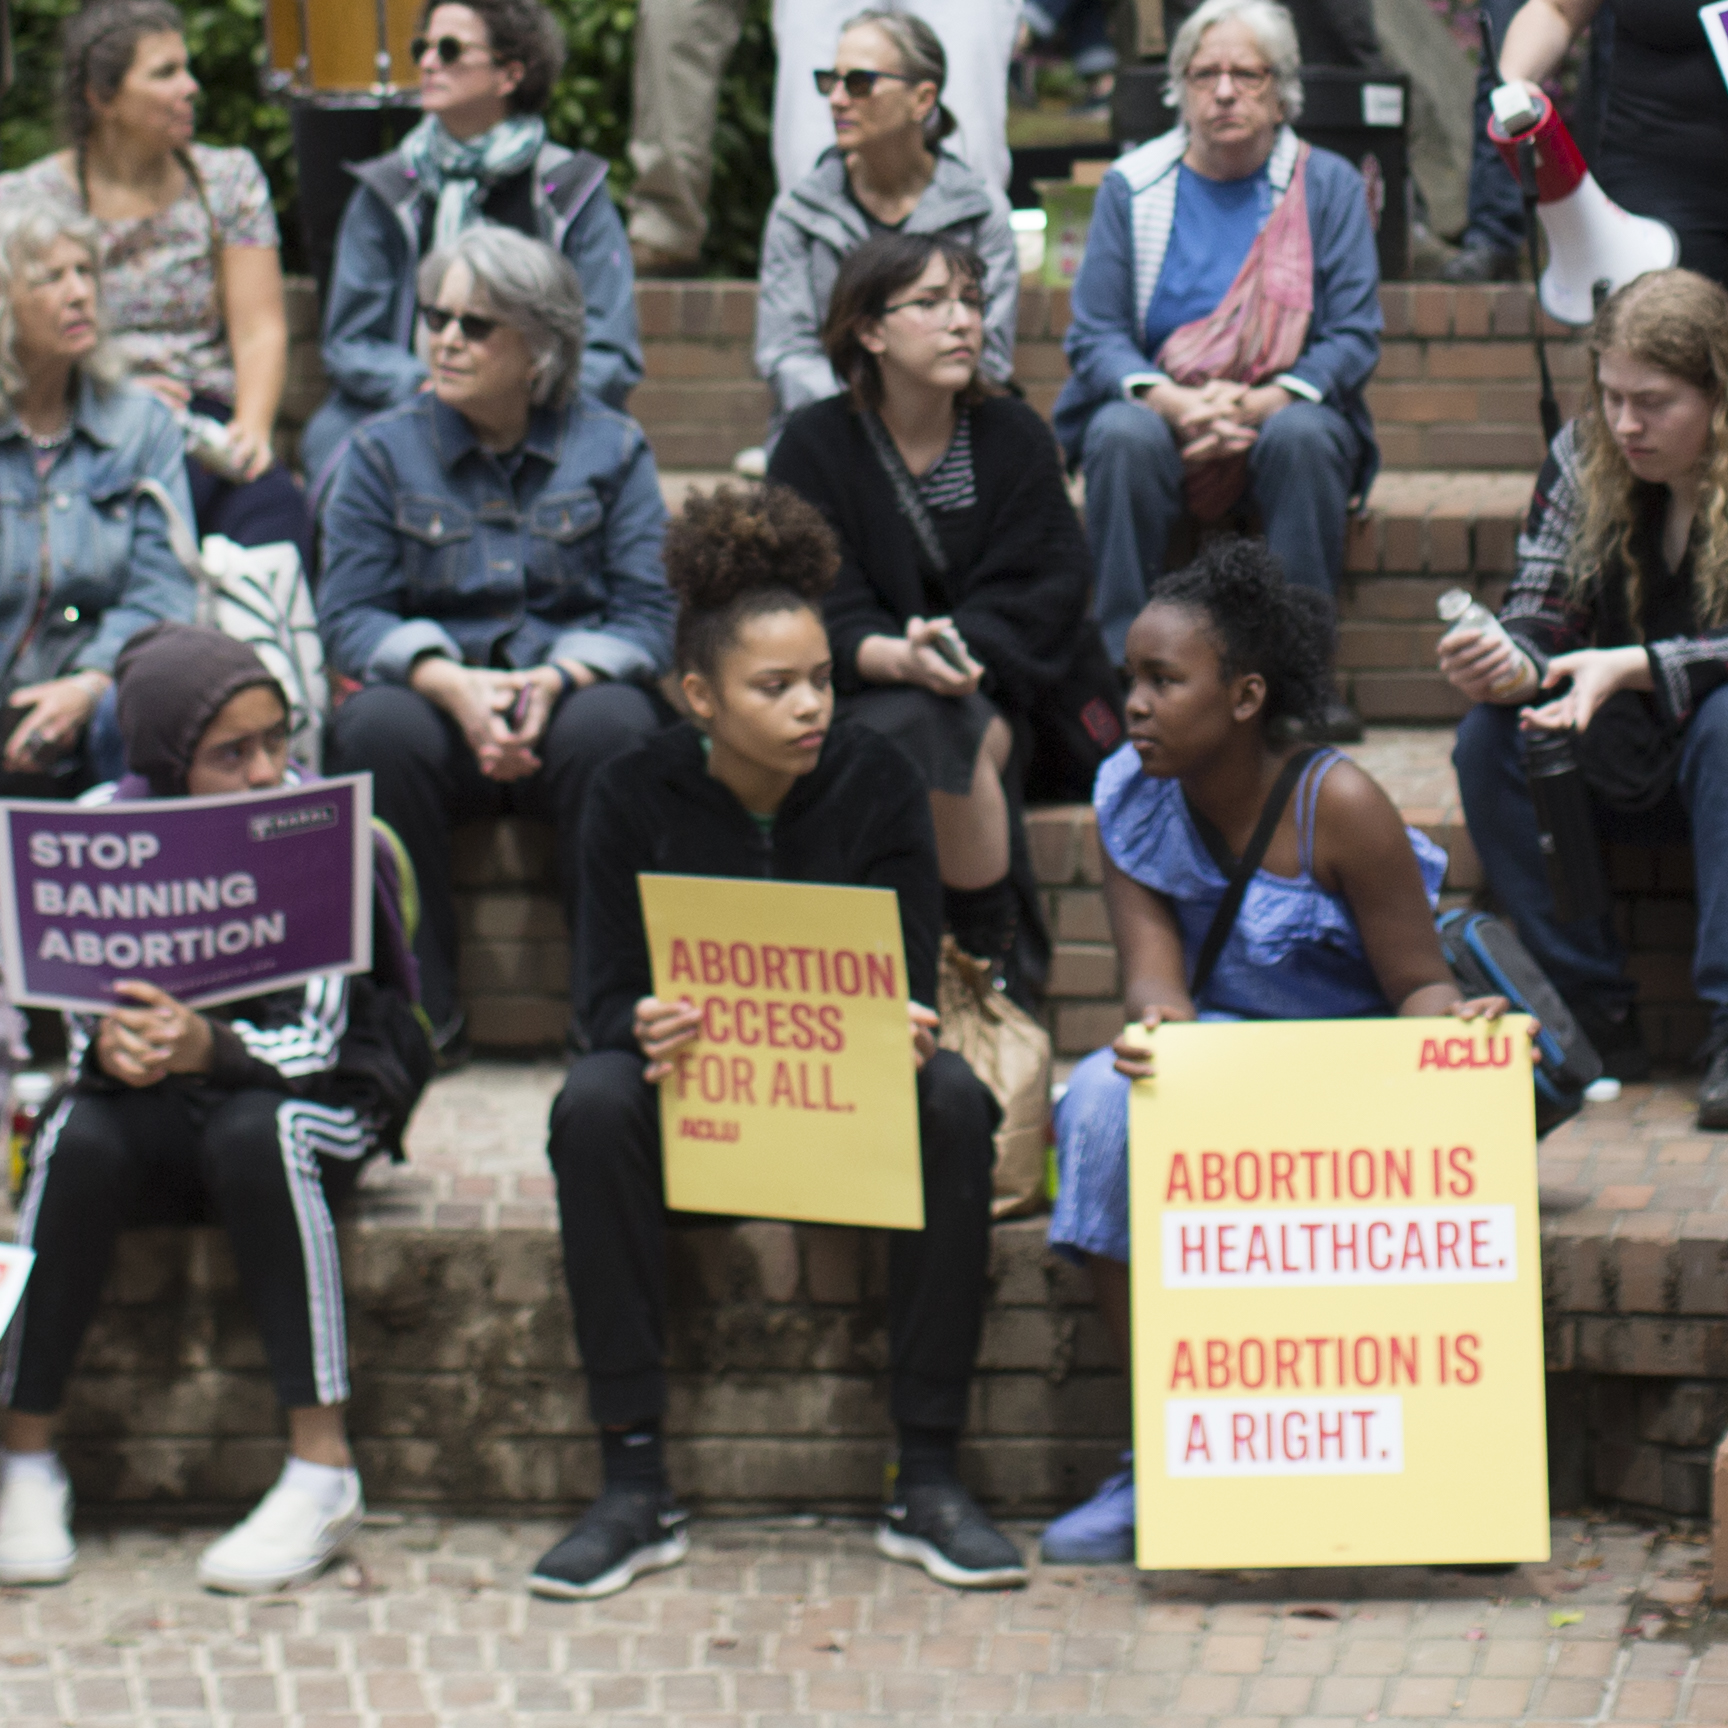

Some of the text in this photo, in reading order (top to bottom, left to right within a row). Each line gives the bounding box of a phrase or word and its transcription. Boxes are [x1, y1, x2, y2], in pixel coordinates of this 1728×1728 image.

[29, 831, 160, 870] STOP
[32, 872, 257, 919] BANNING
[38, 910, 286, 969] ABORTION
[669, 936, 897, 1000] ABORTION
[680, 995, 845, 1053] CCESS
[1418, 1036, 1514, 1071] ACLU
[676, 1051, 856, 1114] FOR ALL.
[1165, 1146, 1476, 1203] ABORTION IS
[1180, 1218, 1507, 1274] HEALTHCARE.
[1169, 1333, 1483, 1391] ABORTION IS
[1184, 1409, 1389, 1464] A RIGHT.
